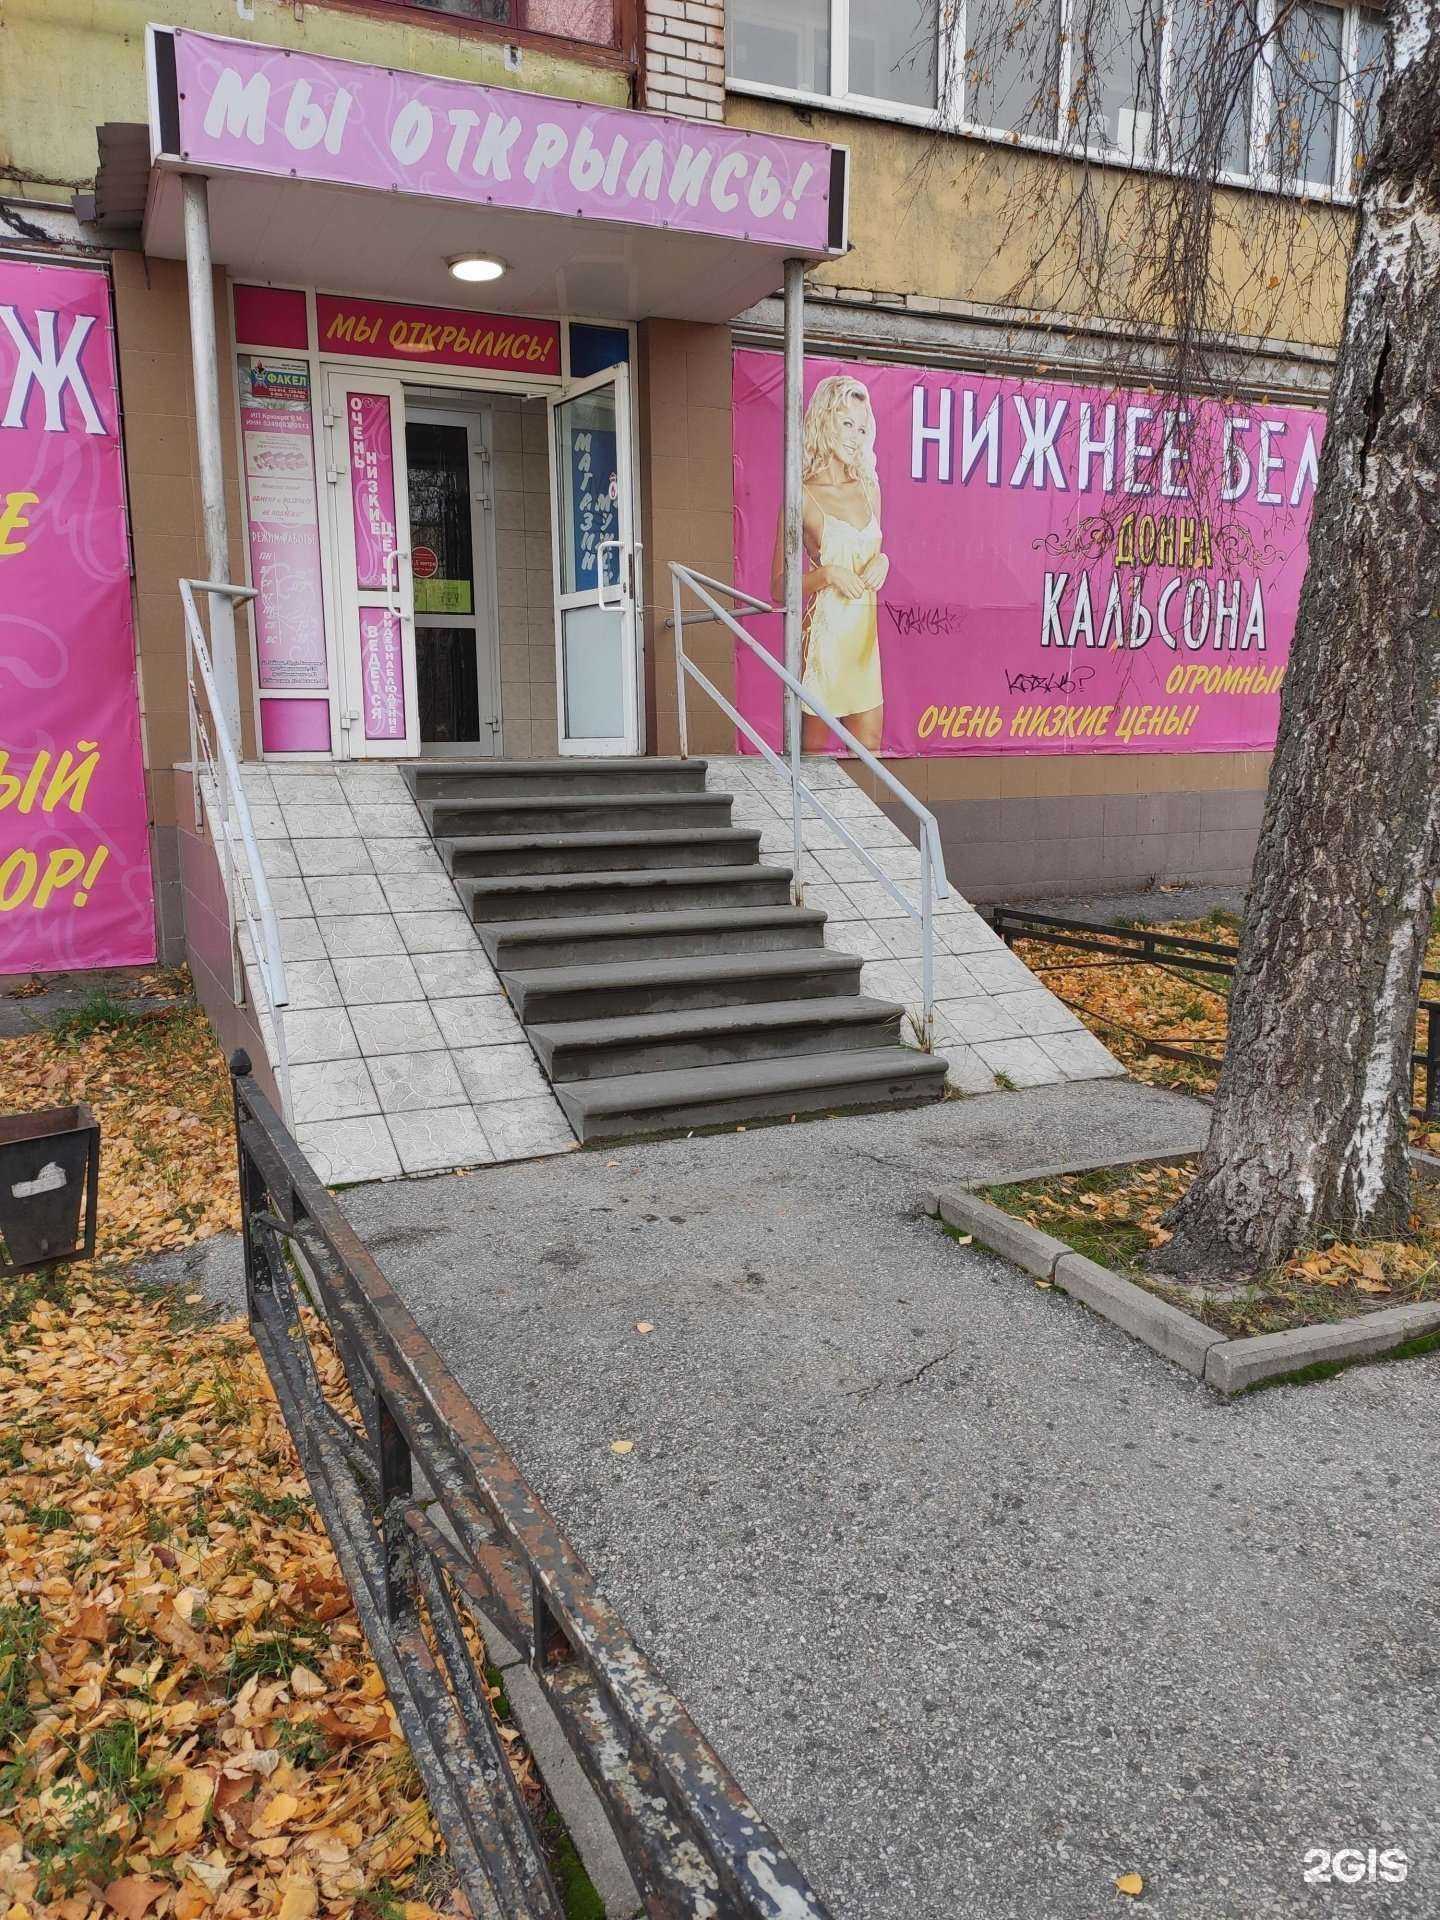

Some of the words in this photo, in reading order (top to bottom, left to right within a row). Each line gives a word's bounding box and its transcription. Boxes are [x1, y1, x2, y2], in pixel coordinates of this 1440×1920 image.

[203, 66, 353, 155] МЫ
[390, 99, 813, 221] ОТКРЫЛИСЬ!
[326, 313, 382, 344] МЫ
[388, 319, 554, 362] ОТКРЫЛИСЬ!
[267, 373, 307, 387] ФАКЕЛ
[350, 396, 366, 469] ОЧЕНЬ
[366, 451, 382, 535] НИЗКИЕ
[911, 384, 1191, 498] НИЖНЕЕ
[574, 432, 596, 571] МАГАЗИН
[1115, 512, 1214, 569] ДОННА
[1041, 569, 1267, 651] КАЛЬСОНА
[917, 704, 1003, 738] ОЧЕНЬ
[1009, 704, 1115, 738] НИЗКИЕ
[1115, 704, 1200, 744] ЦЕНЫ!
